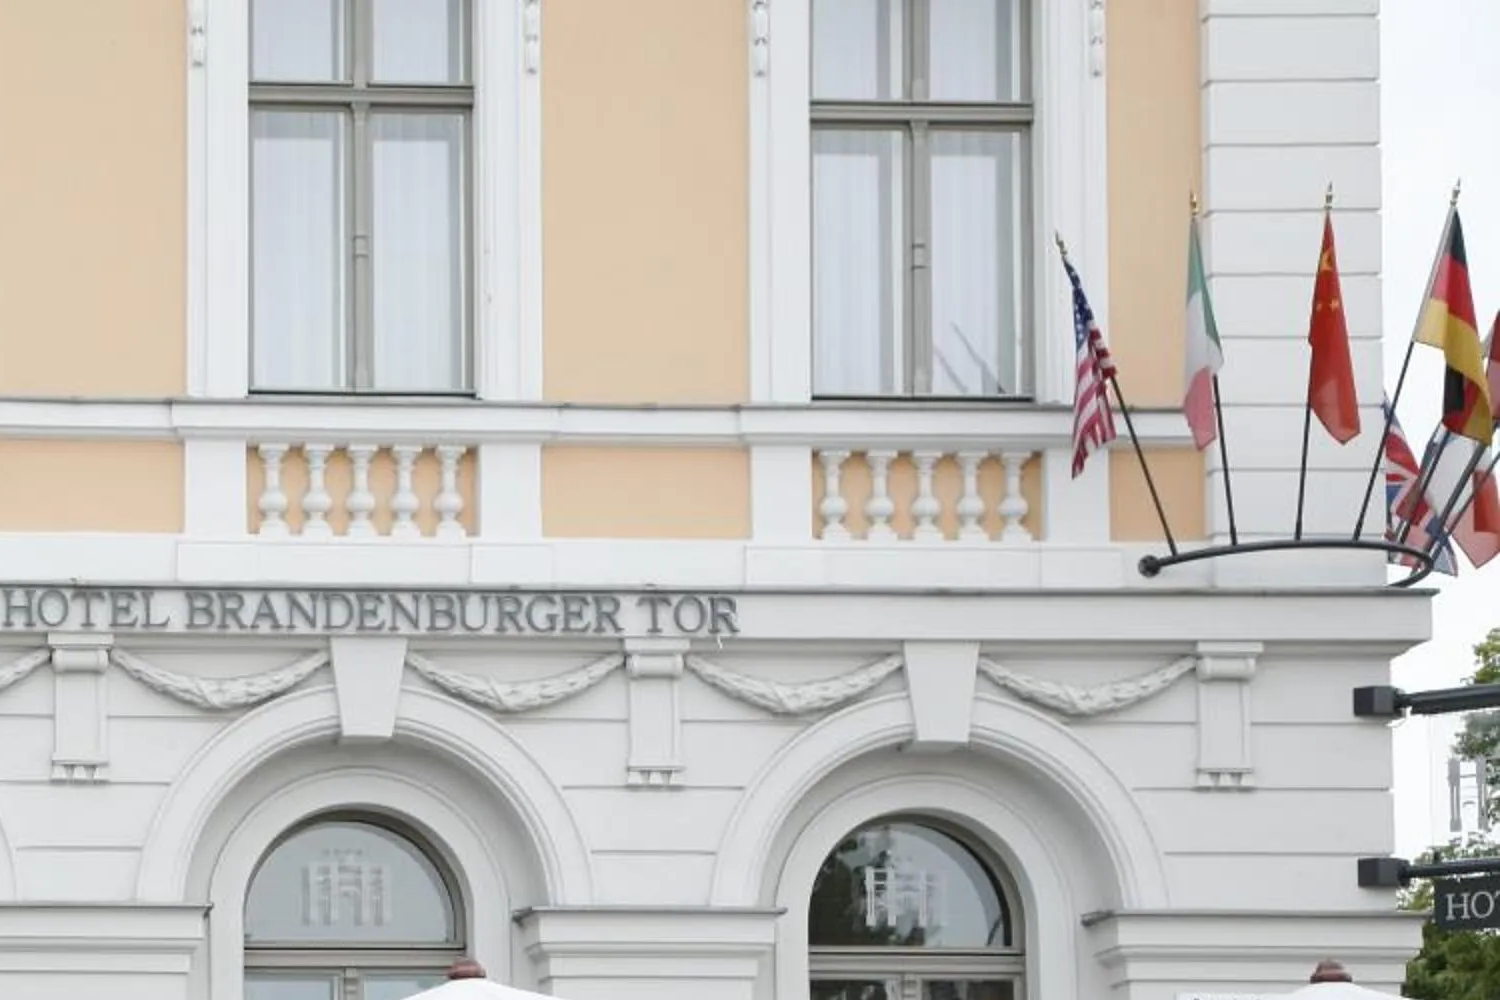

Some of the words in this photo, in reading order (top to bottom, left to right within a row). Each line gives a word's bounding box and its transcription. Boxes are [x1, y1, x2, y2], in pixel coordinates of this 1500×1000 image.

[3, 588, 171, 629] HOTEL
[185, 590, 625, 633] BRANDENBURGER
[635, 594, 741, 635] TOR
[1445, 890, 1500, 921] HO
